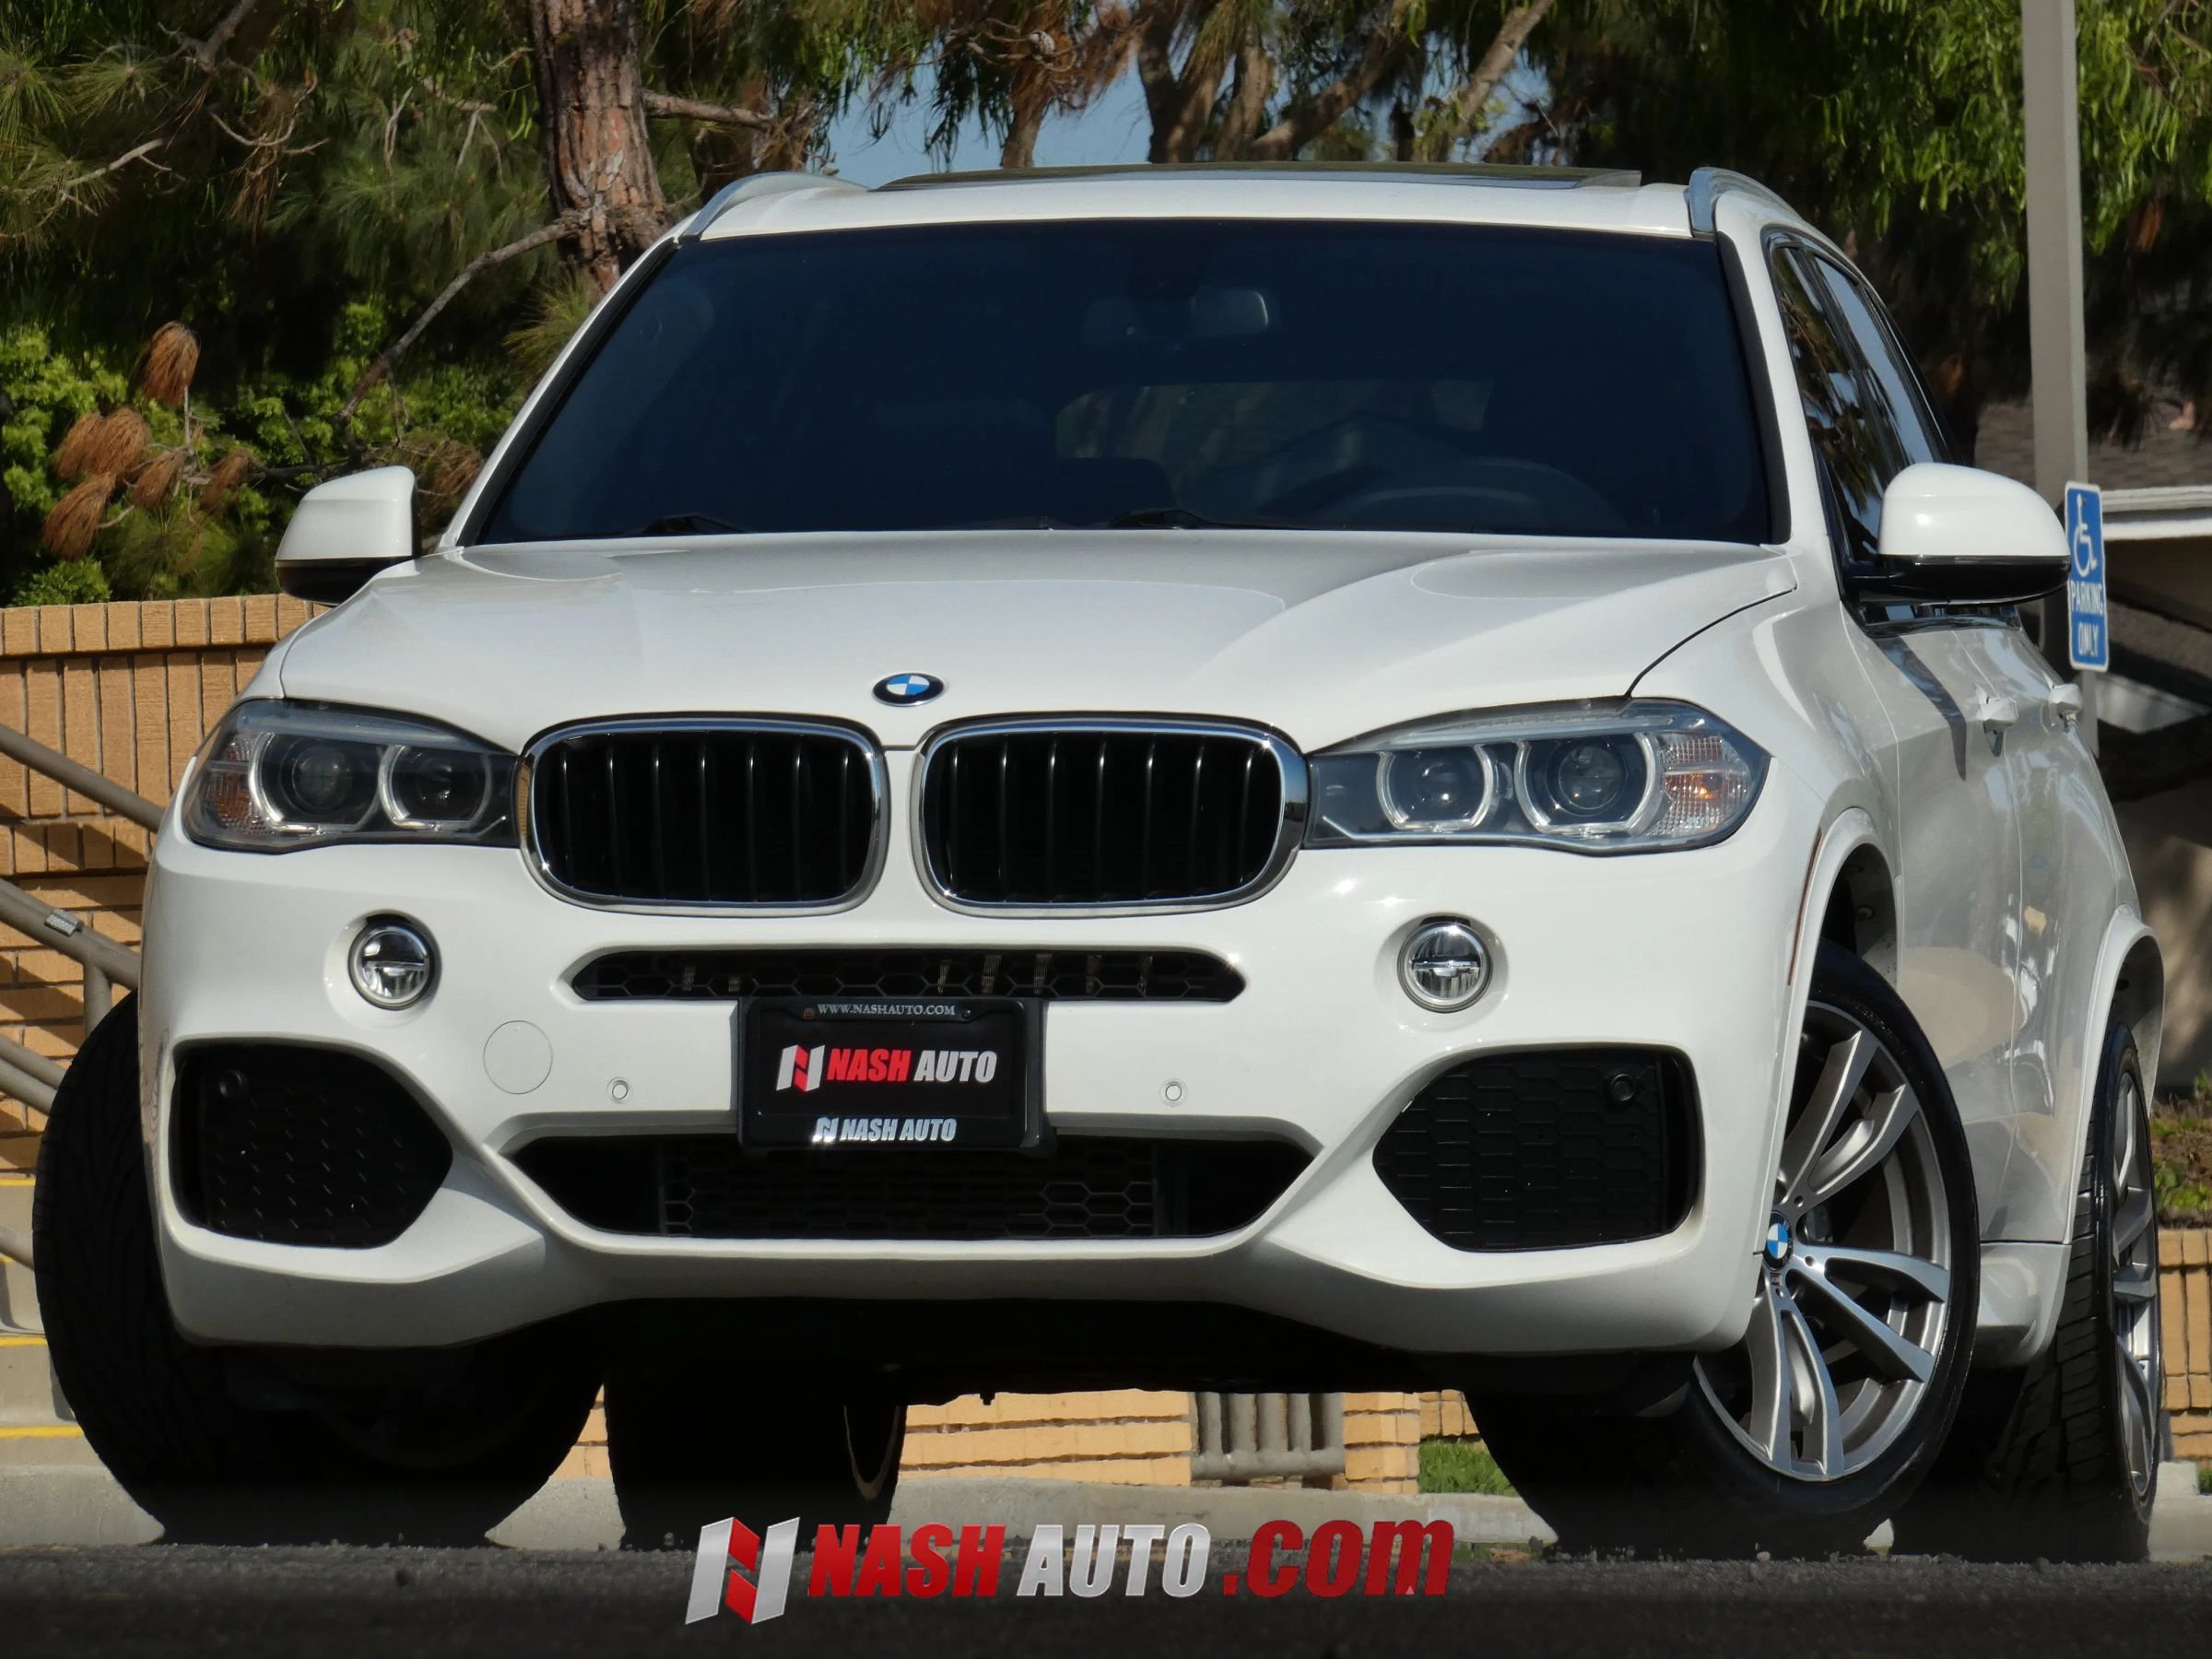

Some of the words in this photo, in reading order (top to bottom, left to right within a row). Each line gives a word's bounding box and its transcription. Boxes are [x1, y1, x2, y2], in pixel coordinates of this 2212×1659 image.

[2071, 580, 2103, 615] PARKING
[2078, 622, 2099, 656] ONLY
[818, 1004, 955, 1016] WWW.NASHAUTO.COM
[827, 1049, 912, 1082] NASH
[913, 1051, 997, 1083] AUTO
[840, 1119, 900, 1141] NASH
[900, 1118, 957, 1141] AUTO
